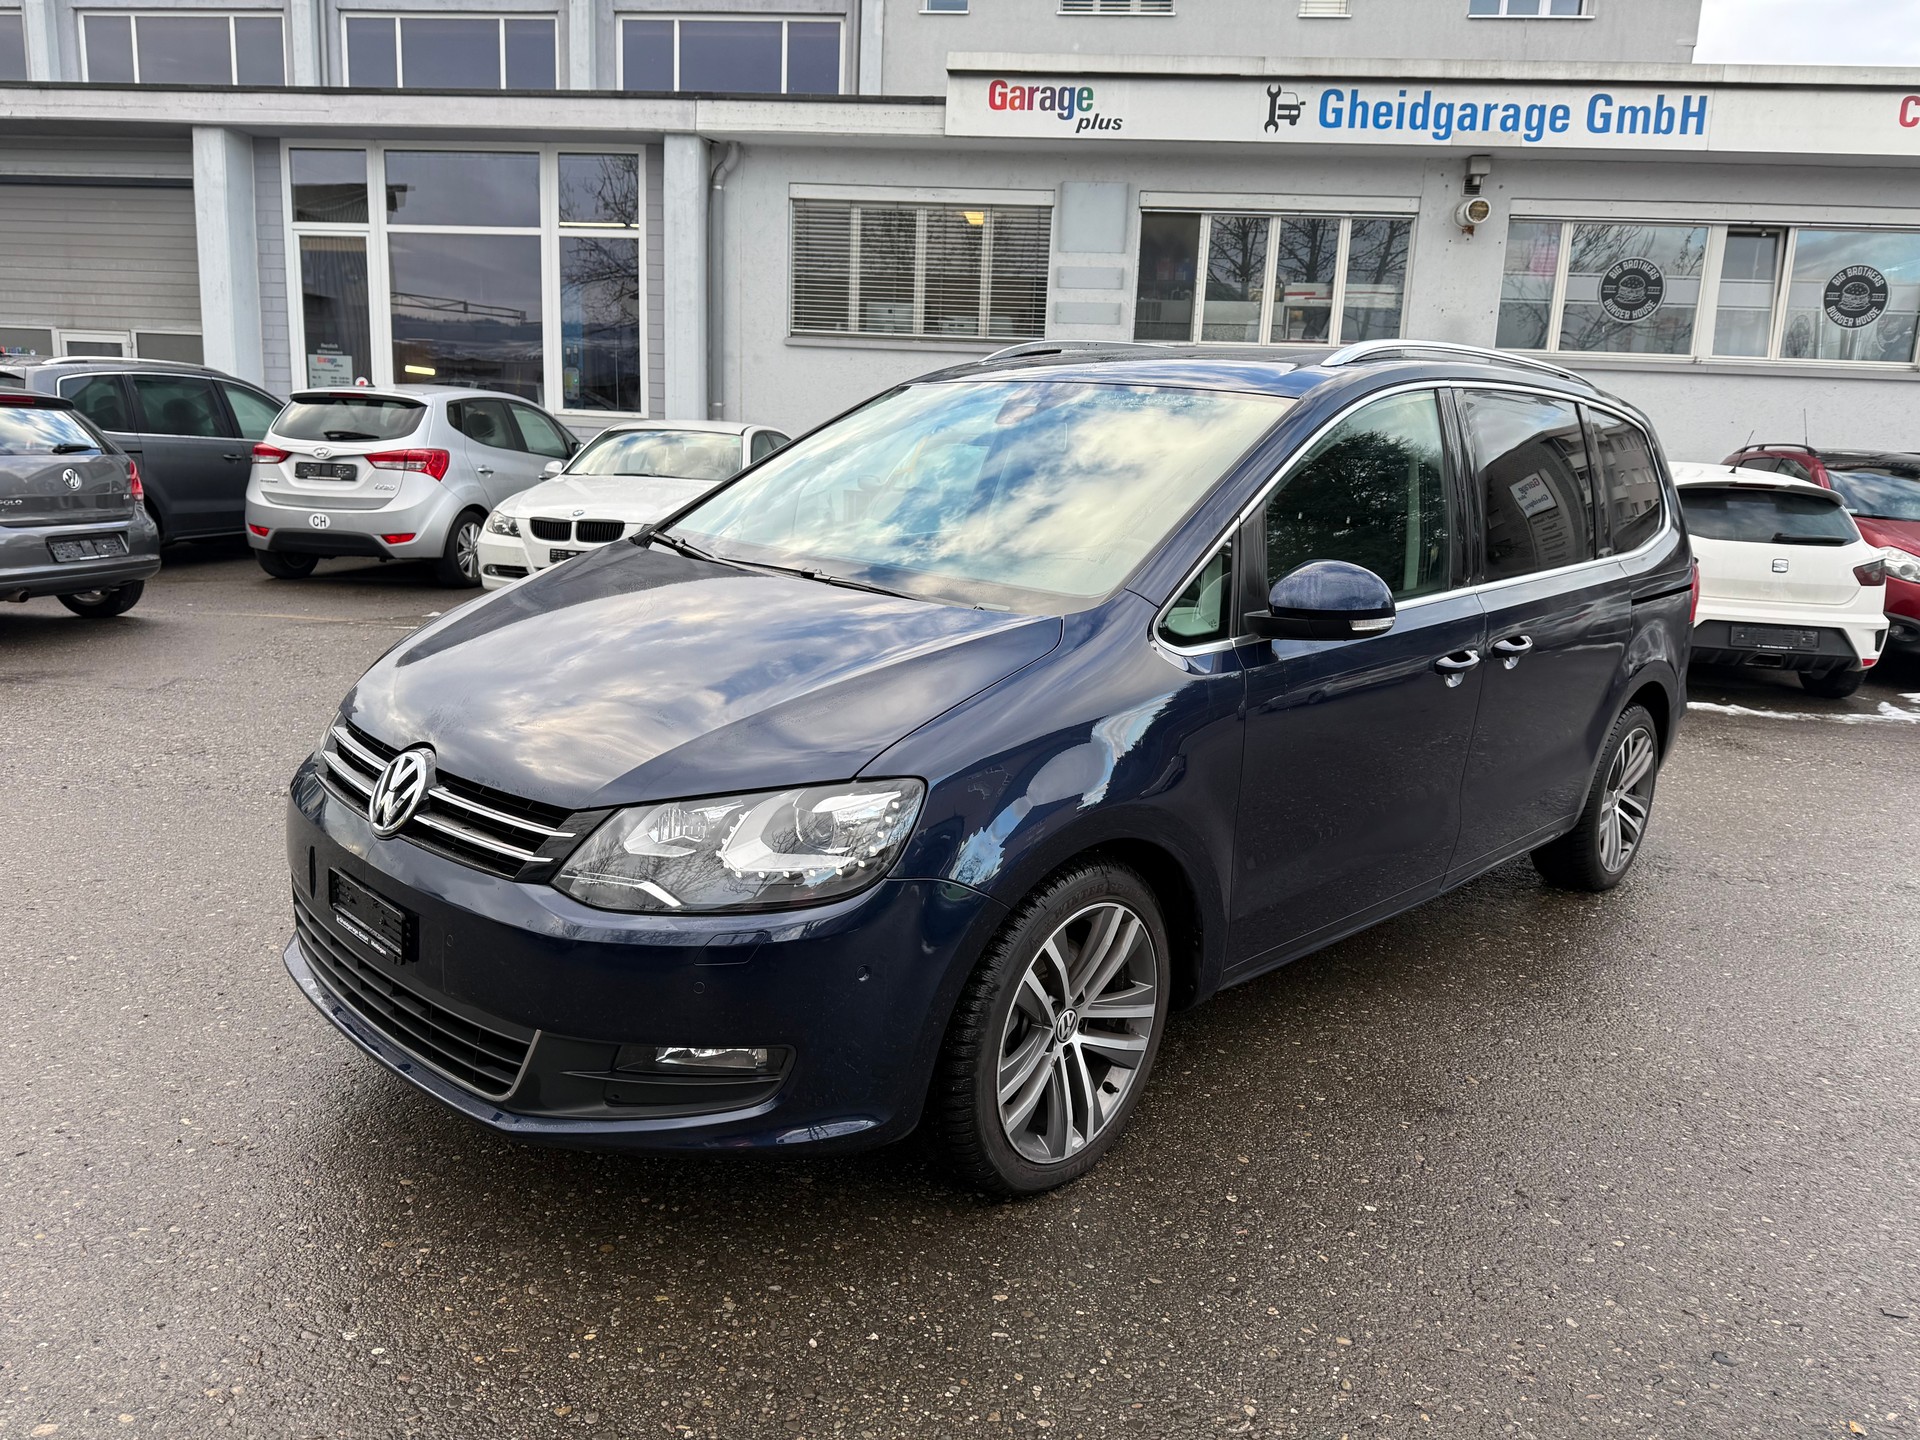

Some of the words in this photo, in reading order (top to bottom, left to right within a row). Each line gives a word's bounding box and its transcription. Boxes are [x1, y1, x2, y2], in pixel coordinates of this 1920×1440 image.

[989, 79, 1094, 121] Garage
[1075, 113, 1123, 133] plus
[1318, 88, 1571, 142] Gheidgarage
[1586, 93, 1708, 135] GmbH
[1608, 265, 1623, 280] BIG
[1622, 260, 1660, 280] BROTHERS
[1832, 272, 1847, 287] BIG
[1846, 266, 1885, 287] BROTHERS
[1603, 298, 1631, 320] BURGER
[1631, 299, 1657, 319] HOUSE
[1826, 305, 1854, 327] BURGER
[1855, 306, 1881, 326] HOUSE
[312, 516, 327, 527] CH
